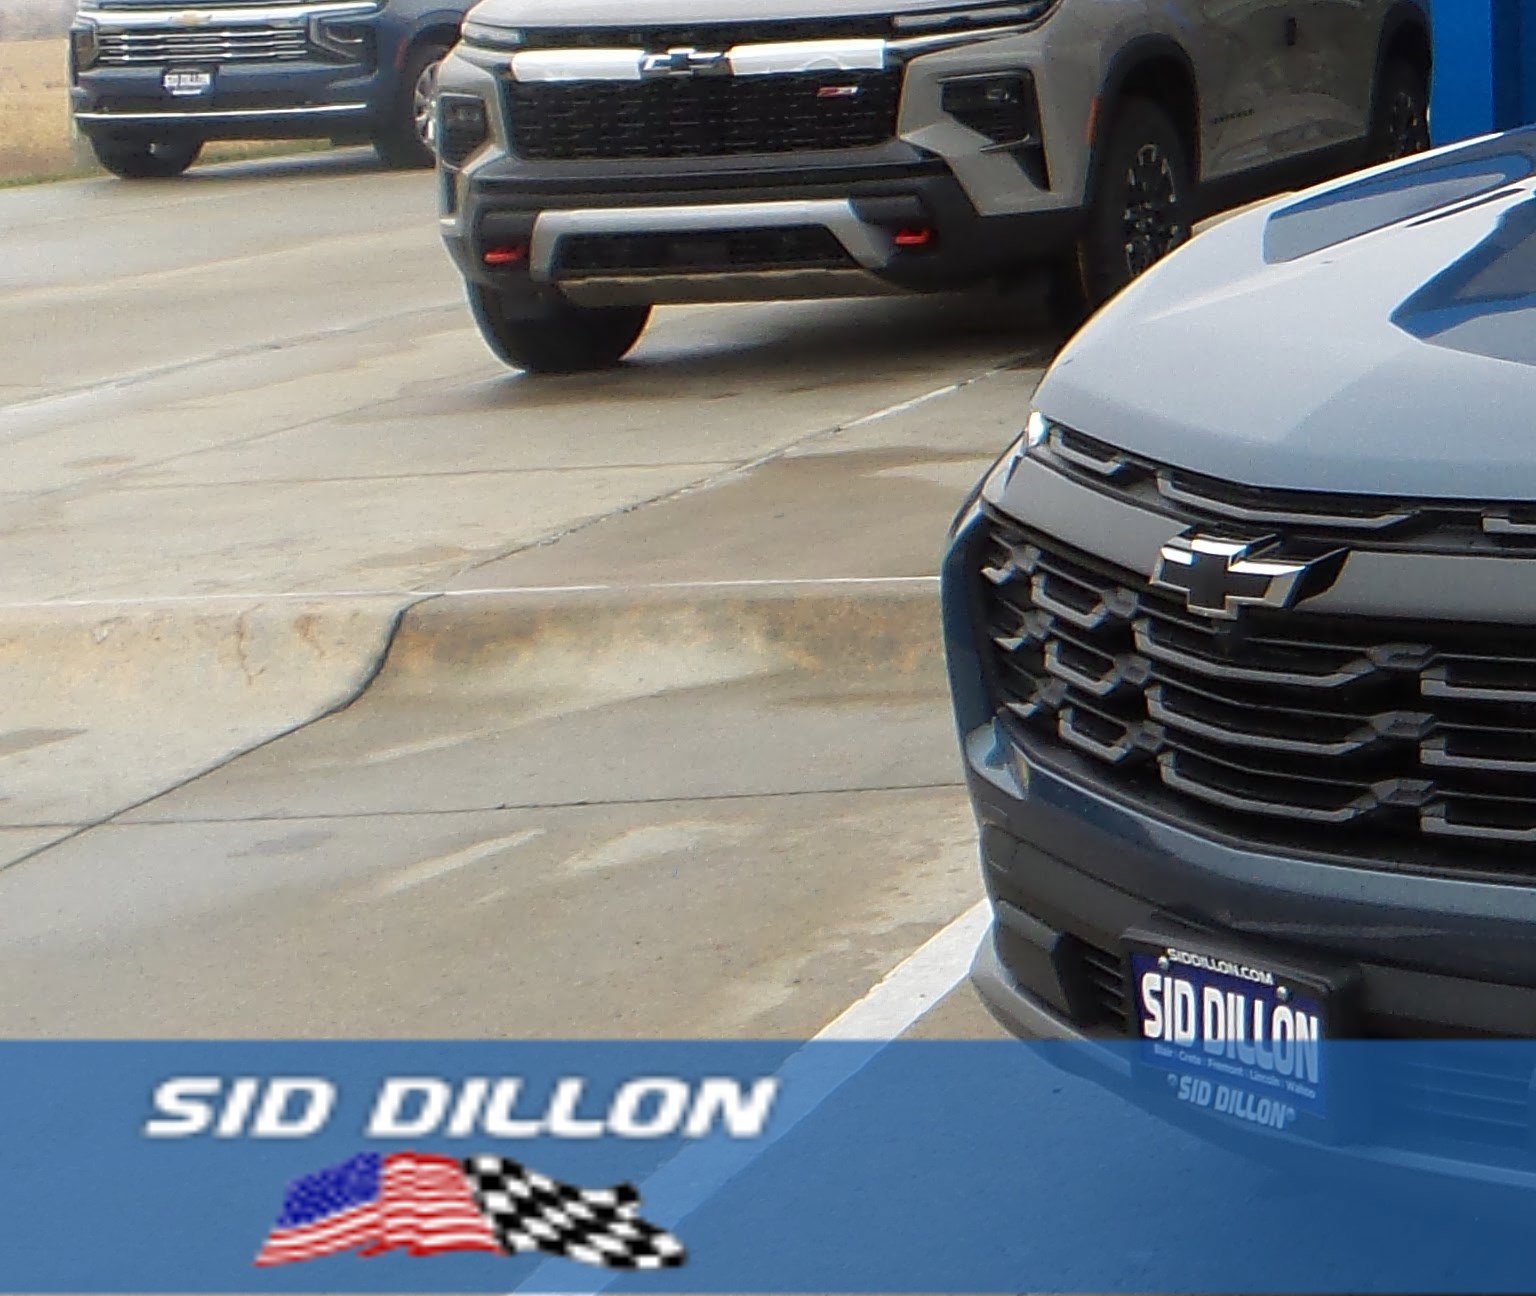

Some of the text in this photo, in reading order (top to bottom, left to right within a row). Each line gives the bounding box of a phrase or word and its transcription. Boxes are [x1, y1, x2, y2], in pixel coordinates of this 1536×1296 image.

[1166, 948, 1274, 986] SIDDILLON.COM
[1141, 971, 1319, 1084] SID DILLON
[1177, 1075, 1288, 1129] SID DILLON
